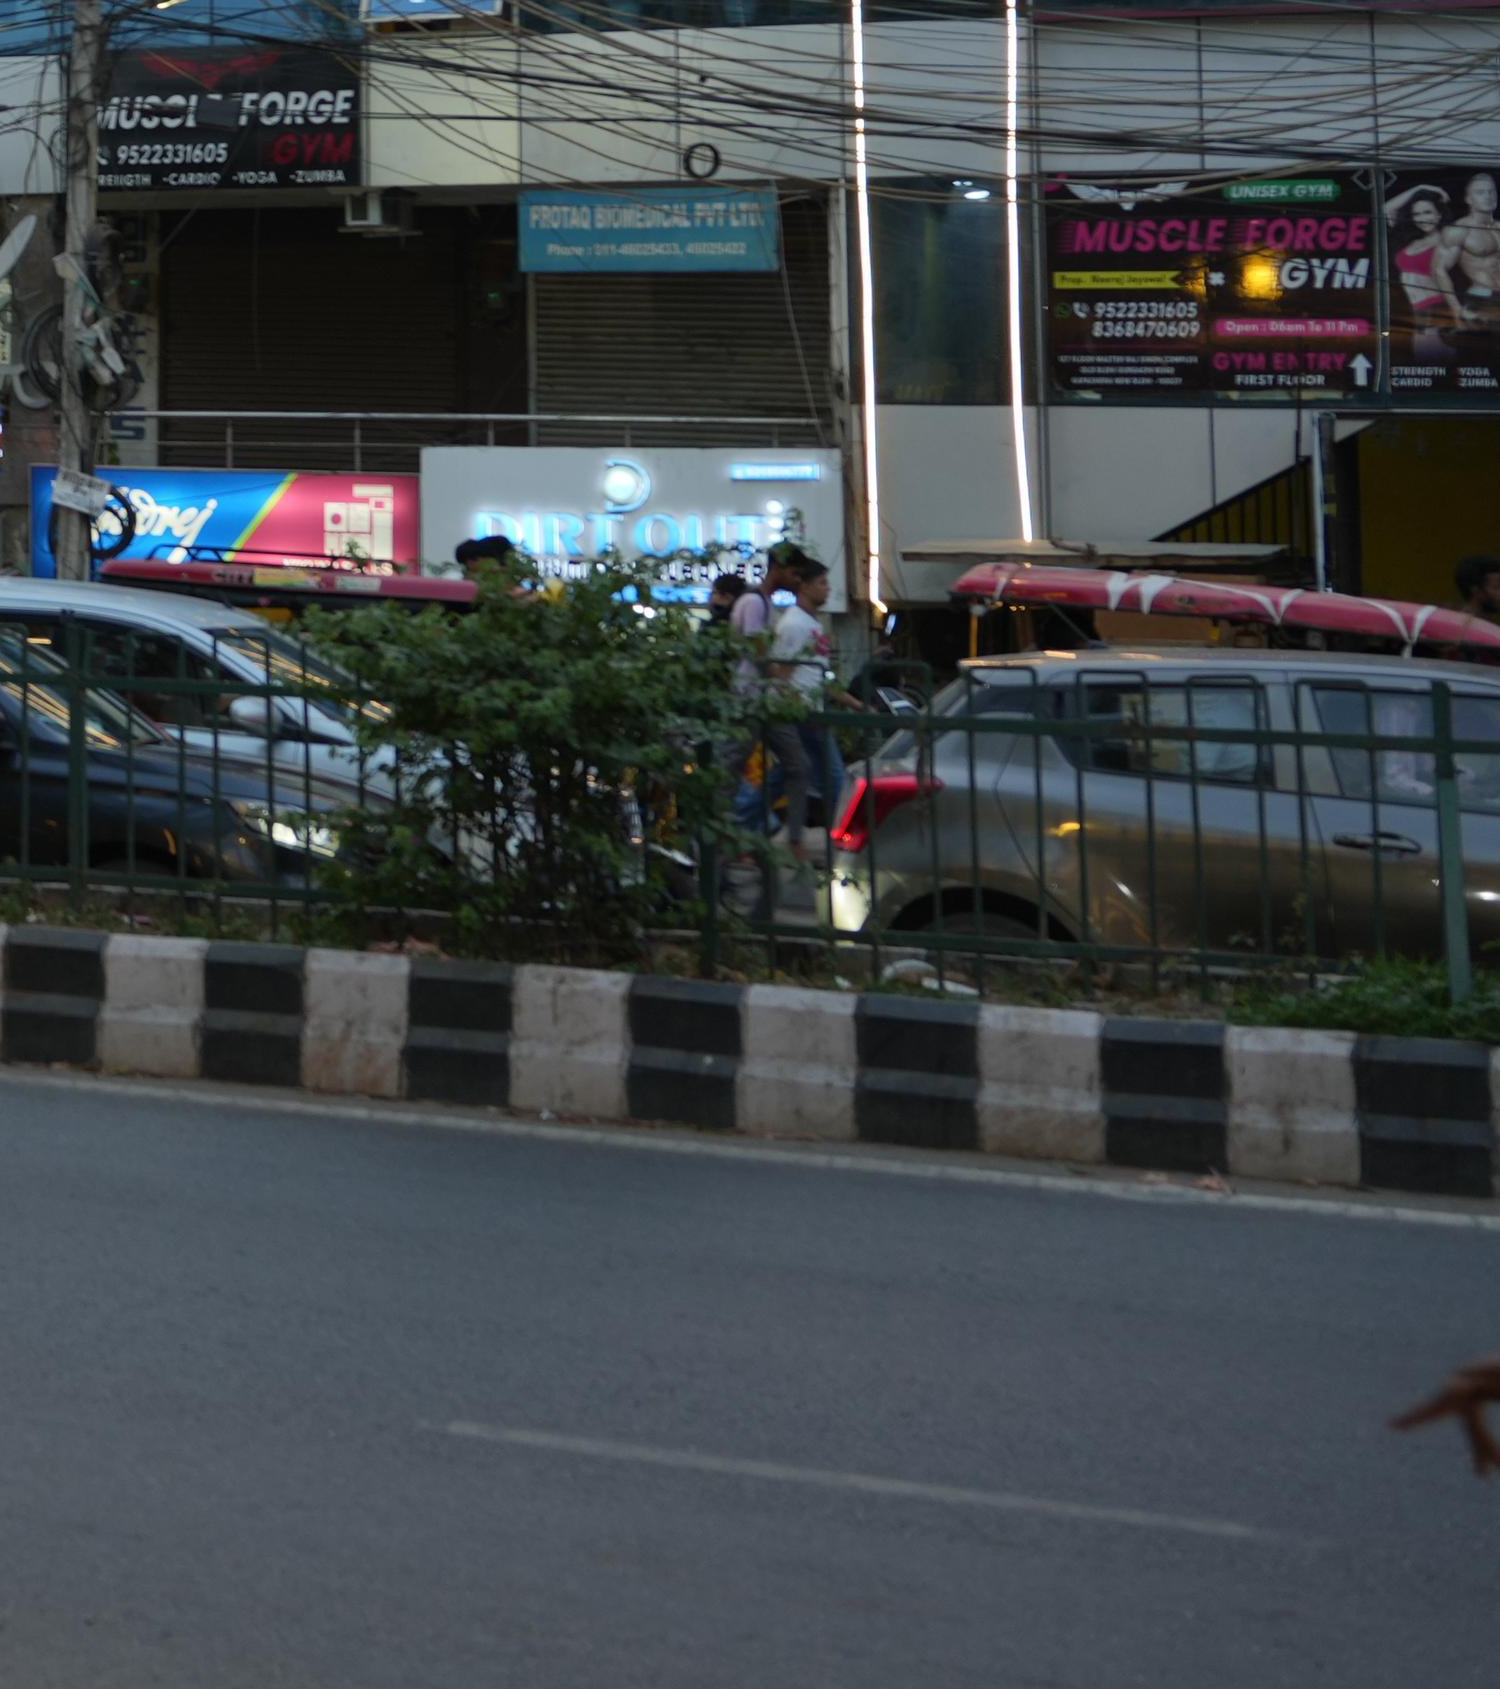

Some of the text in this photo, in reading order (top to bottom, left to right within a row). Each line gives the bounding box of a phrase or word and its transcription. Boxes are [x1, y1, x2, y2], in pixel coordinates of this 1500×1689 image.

[238, 90, 354, 126] FORGE
[272, 133, 356, 165] GYM
[1294, 184, 1334, 198] GYM
[1074, 217, 1369, 252] MUSCLE FORGE
[1280, 258, 1370, 289] GYM
[1212, 352, 1266, 370] GYM
[1234, 375, 1274, 385] FIRST
[474, 513, 625, 556] DIRT
